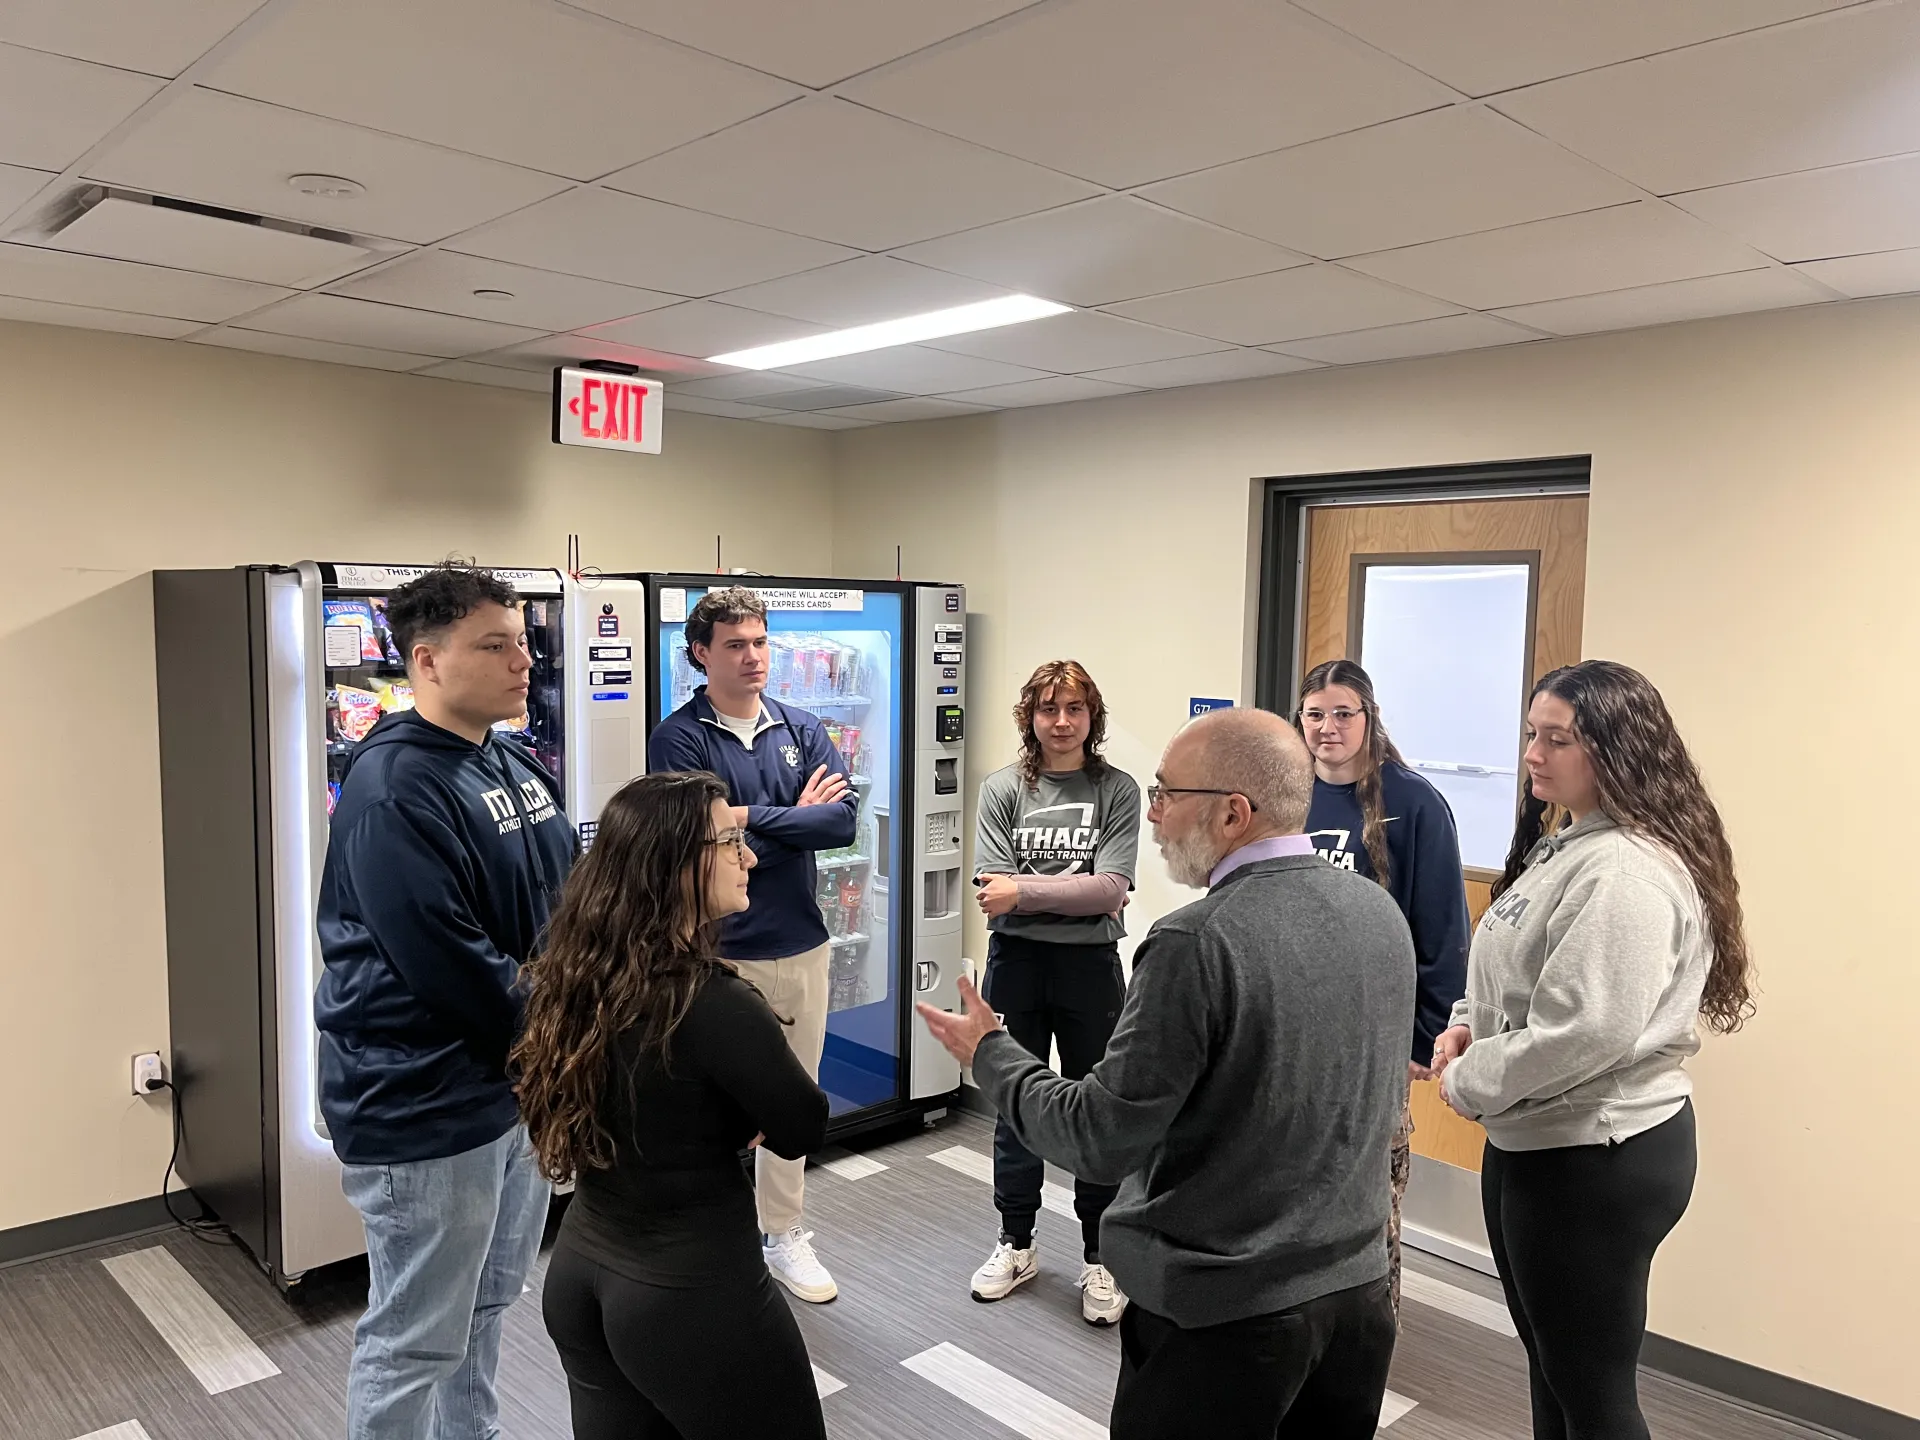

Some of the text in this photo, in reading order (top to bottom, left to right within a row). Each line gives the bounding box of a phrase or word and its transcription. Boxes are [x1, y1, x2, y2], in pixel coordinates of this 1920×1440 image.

[582, 378, 649, 443] EXIT
[385, 568, 411, 576] THIS
[762, 590, 797, 598] MACHINE
[800, 591, 819, 600] WILL
[820, 592, 849, 600] ACCEPT:
[771, 600, 805, 609] EXPRESS
[806, 601, 832, 609] CARDS
[1016, 850, 1055, 860] THLETIC
